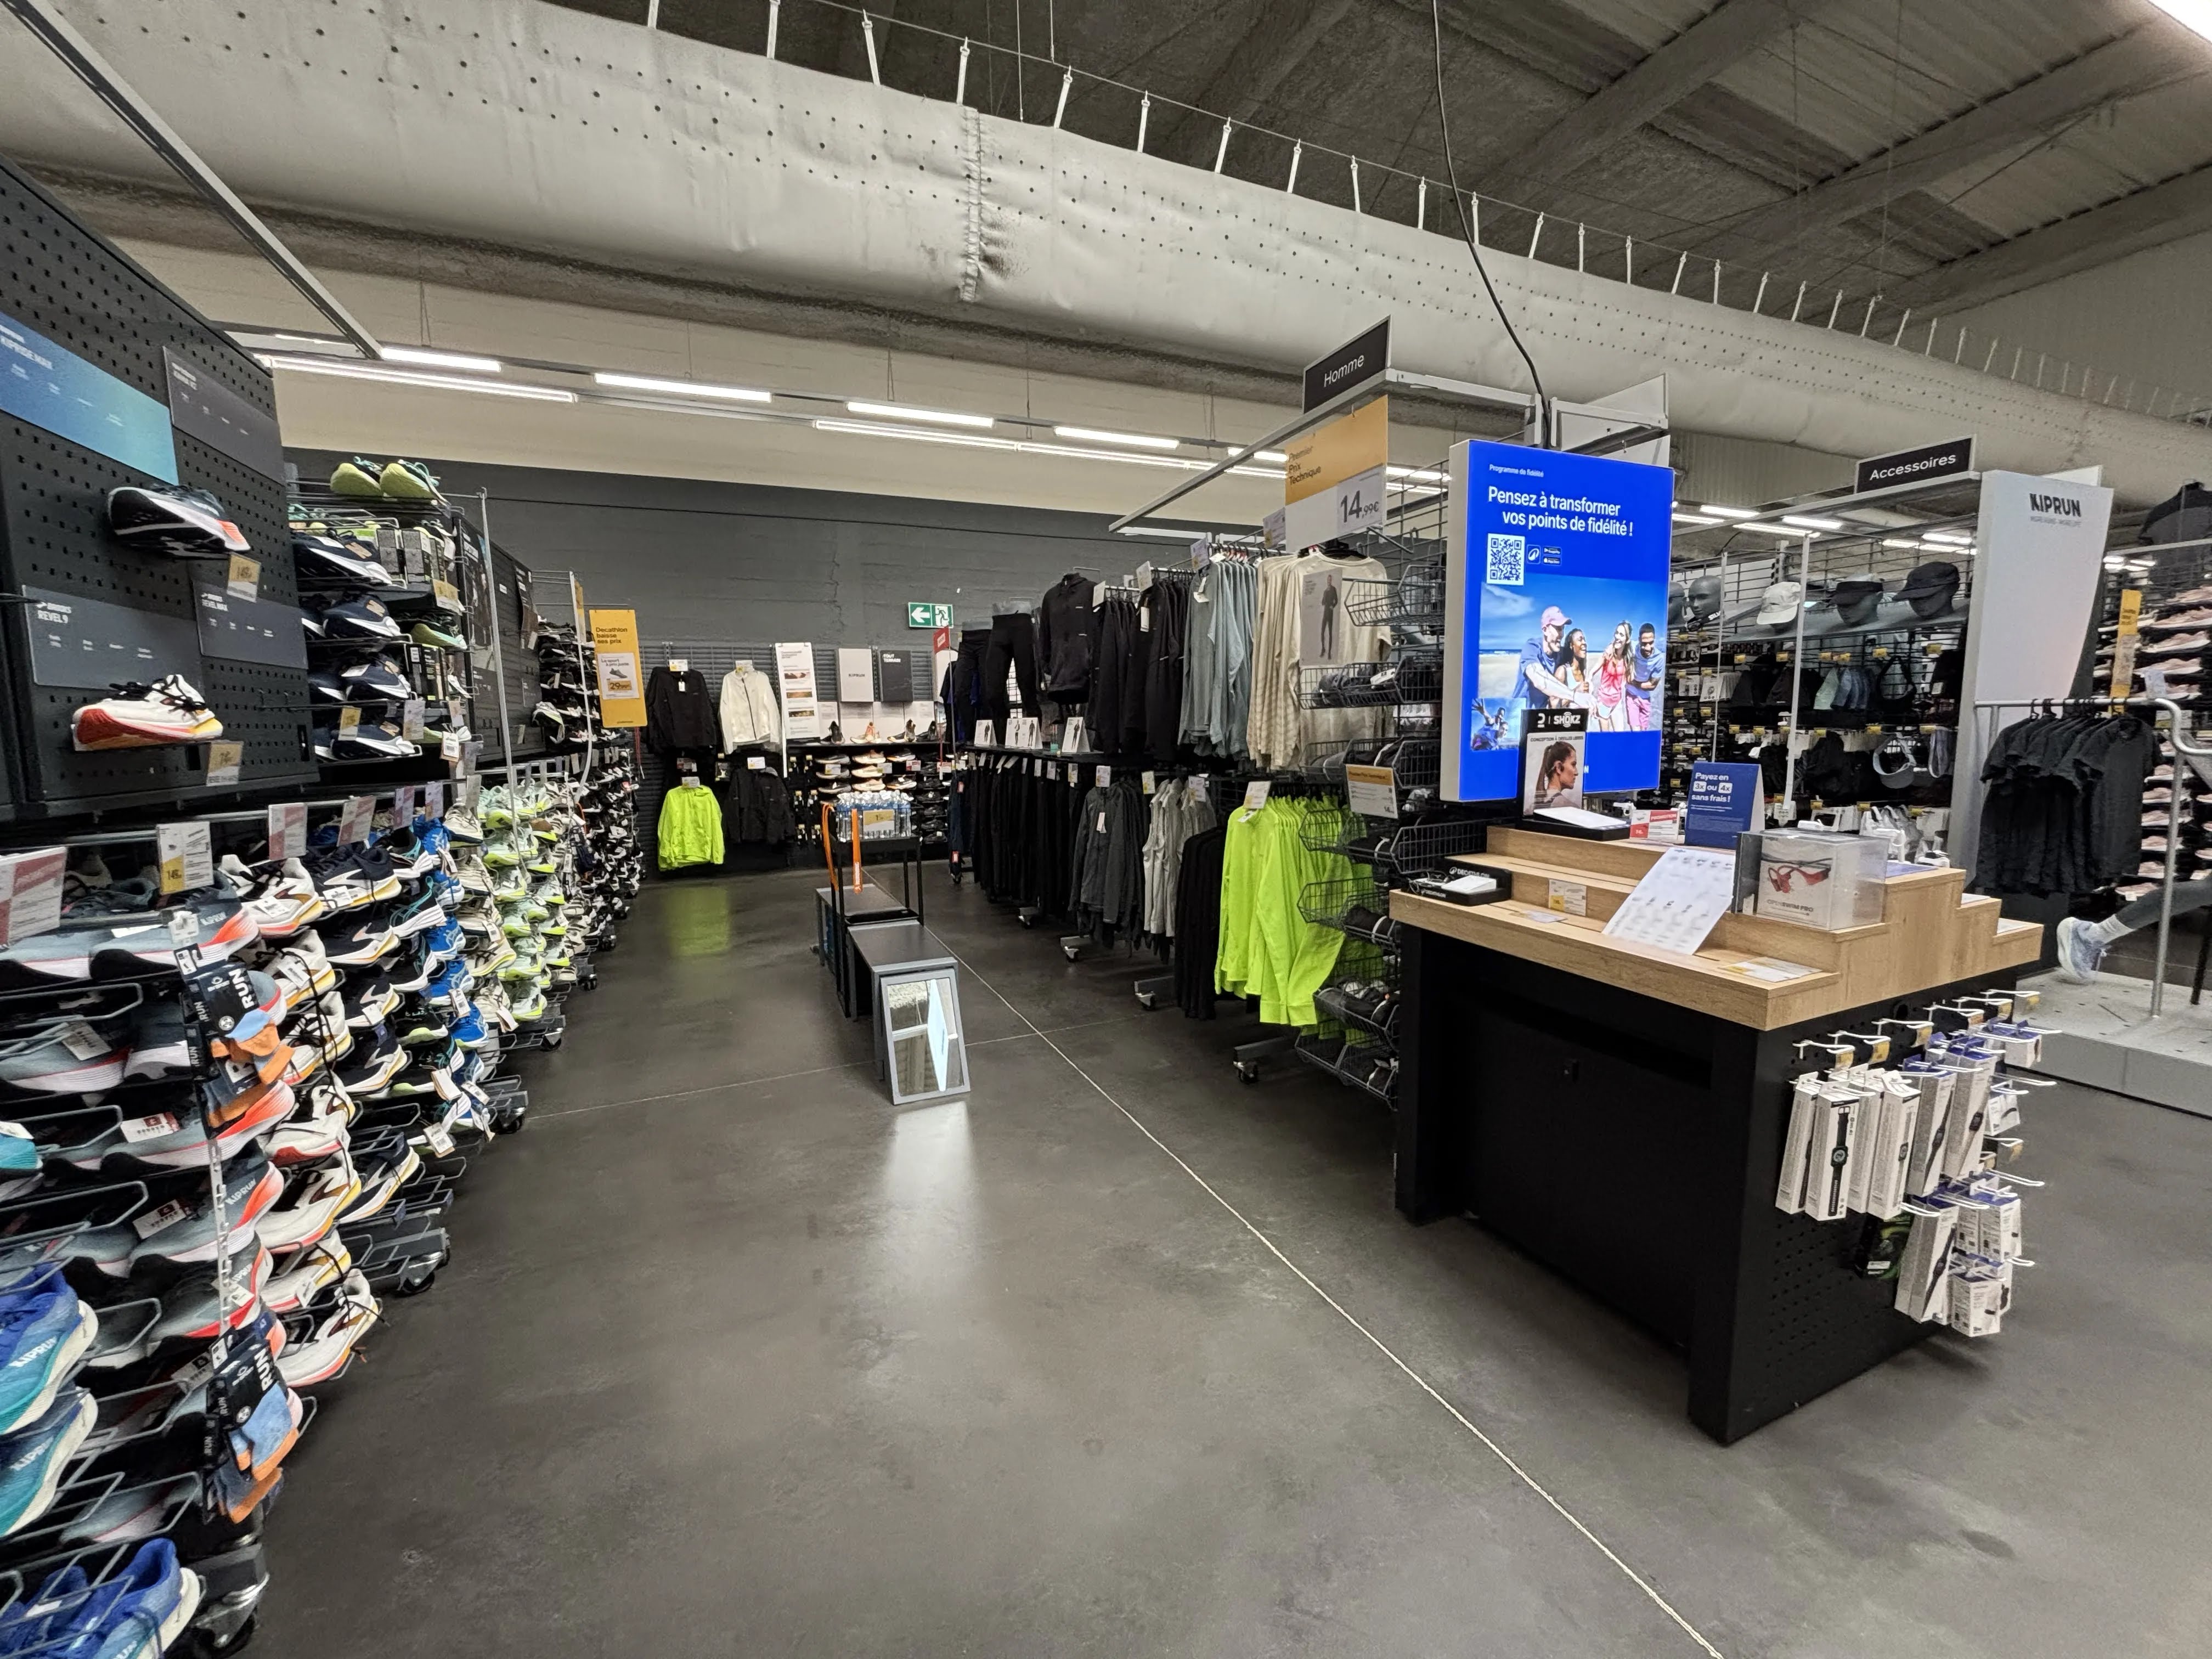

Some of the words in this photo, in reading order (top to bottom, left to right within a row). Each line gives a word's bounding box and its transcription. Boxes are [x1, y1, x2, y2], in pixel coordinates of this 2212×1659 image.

[1324, 355, 1364, 387] Homme
[1289, 462, 1301, 472] Prix
[1289, 466, 1321, 485] Technique
[1489, 464, 1519, 473] Programme
[1869, 454, 1957, 481] Accessoires
[1488, 486, 1537, 507] Pensez
[1539, 491, 1547, 507] à
[1549, 494, 1621, 516] transformer
[2029, 493, 2081, 517] KIPRUN
[1502, 511, 1526, 526] vos
[1528, 512, 1568, 530] points
[1570, 516, 1585, 531] de
[1588, 517, 1628, 536] fidélité
[1554, 713, 1581, 726] SHOKZ
[1695, 772, 1718, 781] Payez
[228, 968, 255, 1009] RUN
[254, 1348, 274, 1391] RUN
